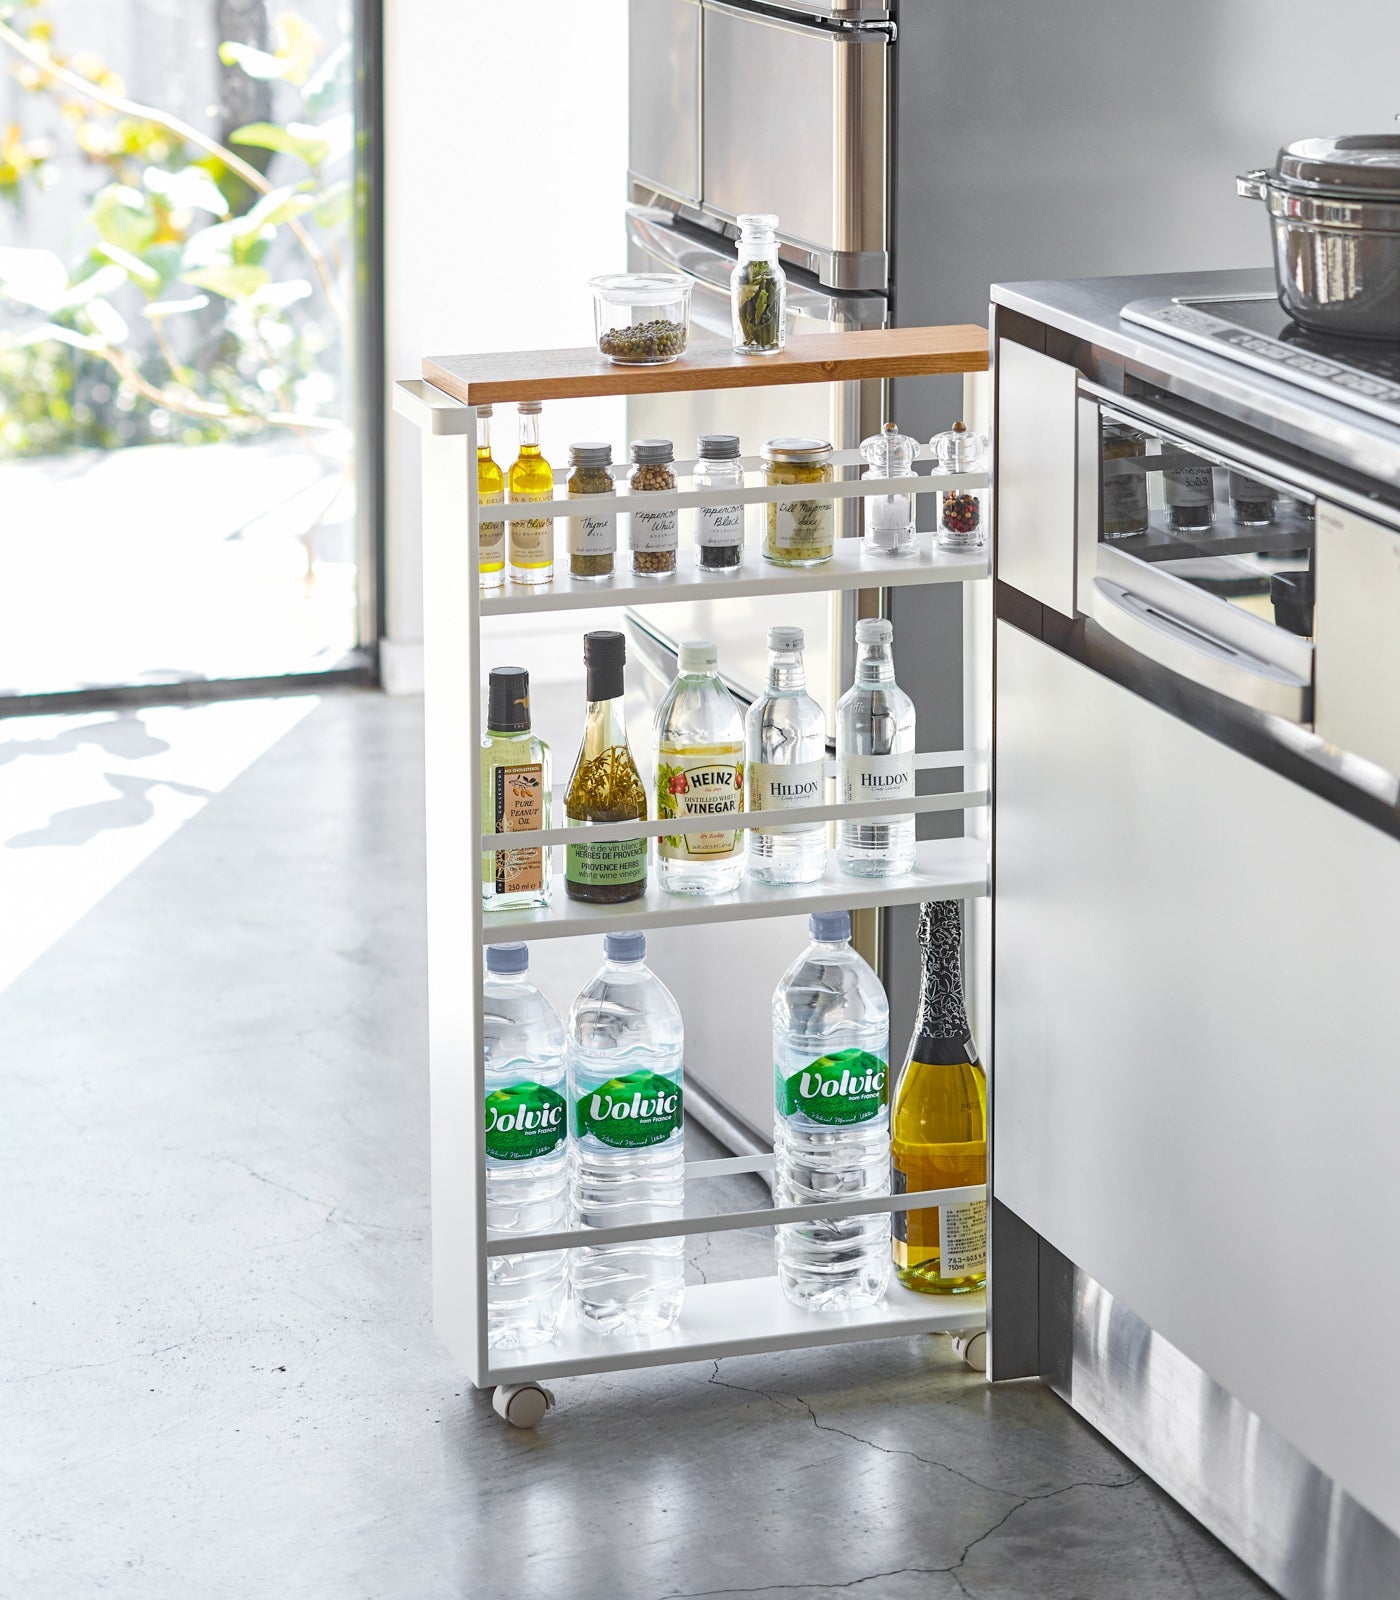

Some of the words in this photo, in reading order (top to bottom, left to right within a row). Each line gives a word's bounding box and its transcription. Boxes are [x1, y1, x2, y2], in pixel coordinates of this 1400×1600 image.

[580, 517, 609, 537] Thyme
[691, 772, 733, 788] HEINZ
[861, 772, 909, 787] HILDON
[770, 780, 818, 796] HILDON
[514, 800, 534, 808] PURE
[686, 800, 736, 814] VINEGAR
[510, 808, 539, 817] PEANUT
[575, 849, 601, 860] HERBES
[602, 852, 613, 860] DE
[581, 862, 618, 871] PROVENCE
[619, 860, 640, 870] HERBS
[578, 871, 598, 879] white
[800, 1069, 885, 1099] Volvic
[860, 1092, 880, 1100] France
[589, 1091, 678, 1121] Volvic
[652, 1115, 672, 1123] France
[537, 1126, 557, 1135] France
[947, 1263, 965, 1271] 750ml
